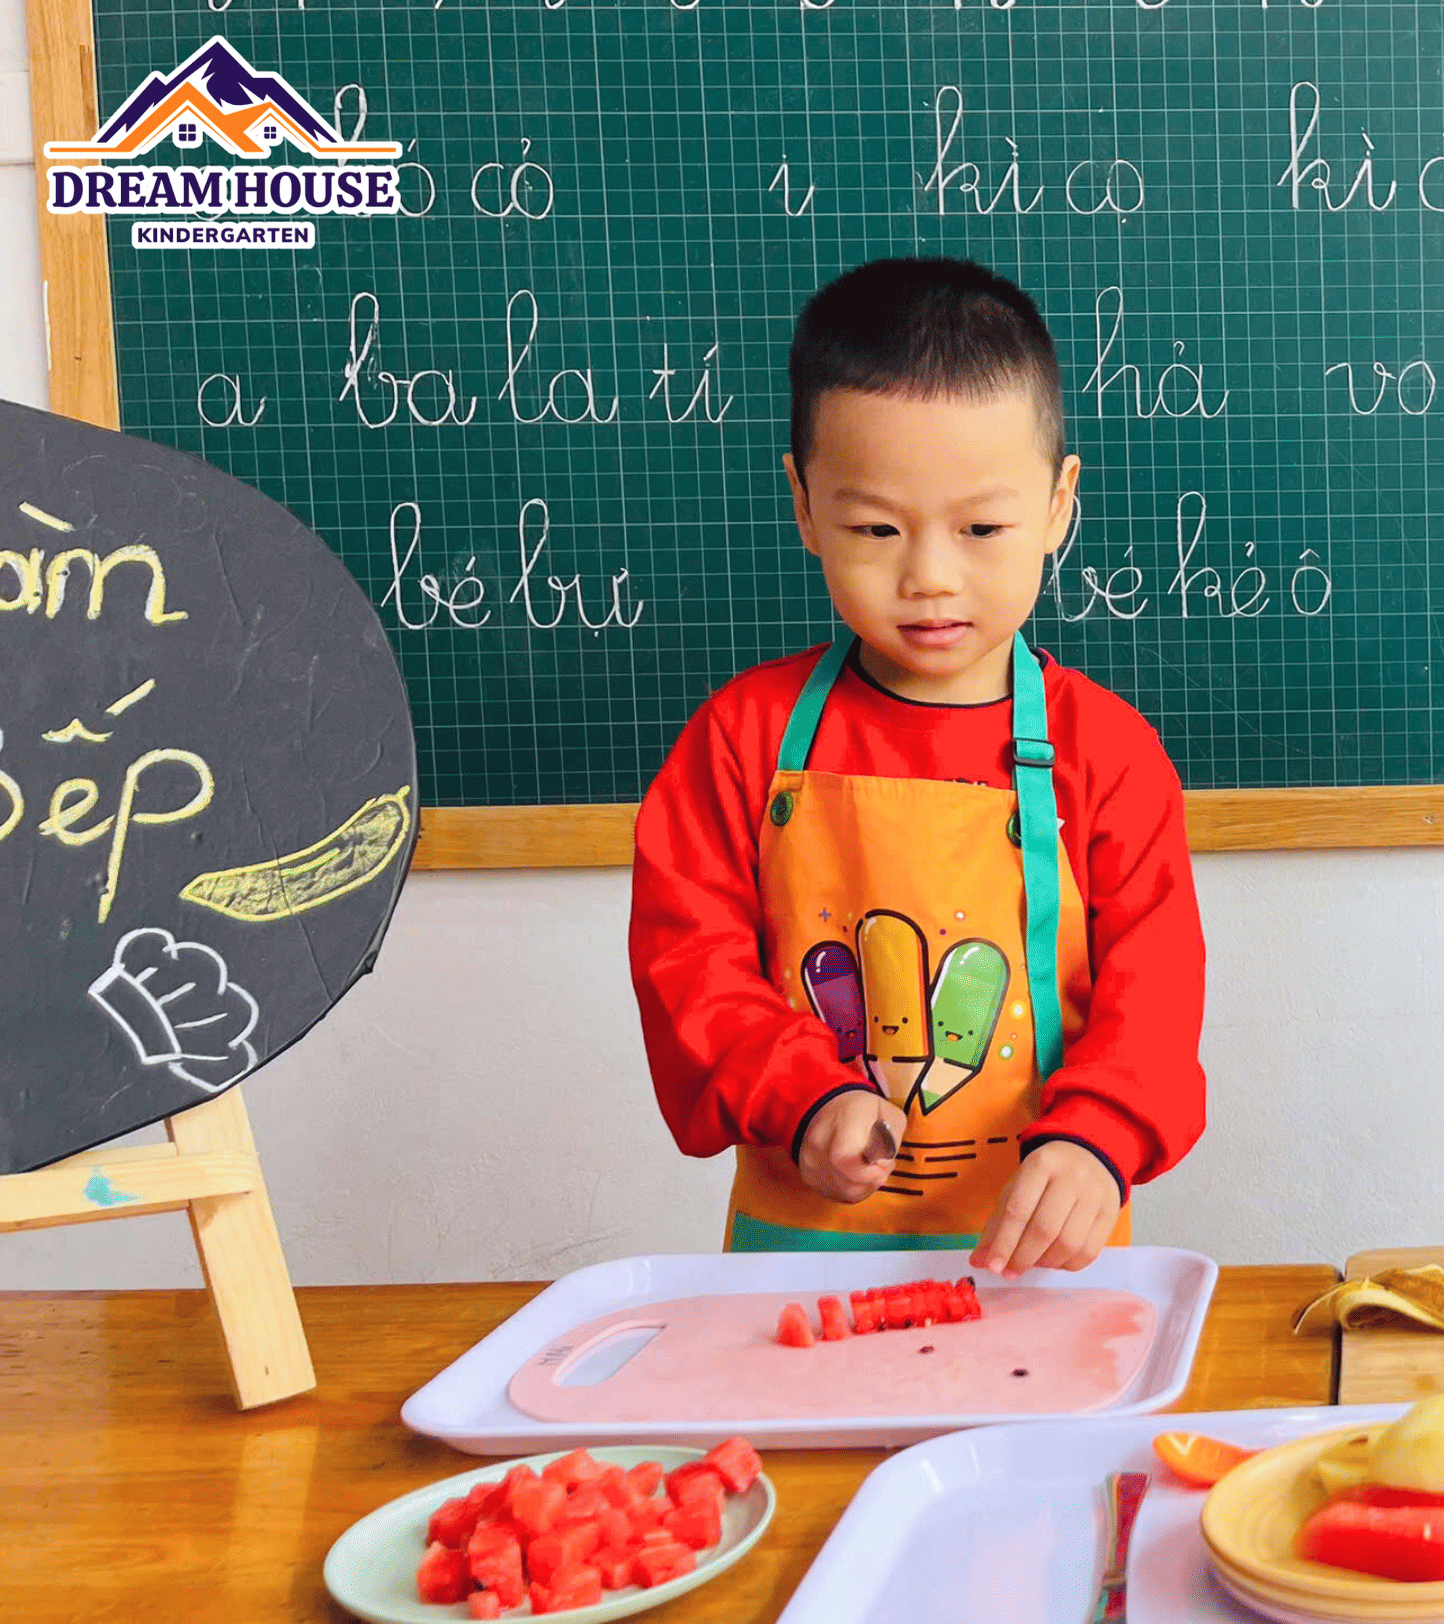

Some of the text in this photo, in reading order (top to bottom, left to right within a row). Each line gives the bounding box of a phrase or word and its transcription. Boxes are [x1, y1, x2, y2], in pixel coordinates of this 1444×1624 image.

[197, 372, 268, 428] a
[338, 291, 478, 430] ba
[497, 288, 619, 423] la
[648, 341, 735, 423] tí
[1081, 286, 1230, 419] hả
[1325, 359, 1438, 416] vo
[380, 501, 492, 630] bé
[1291, 548, 1332, 616] ô
